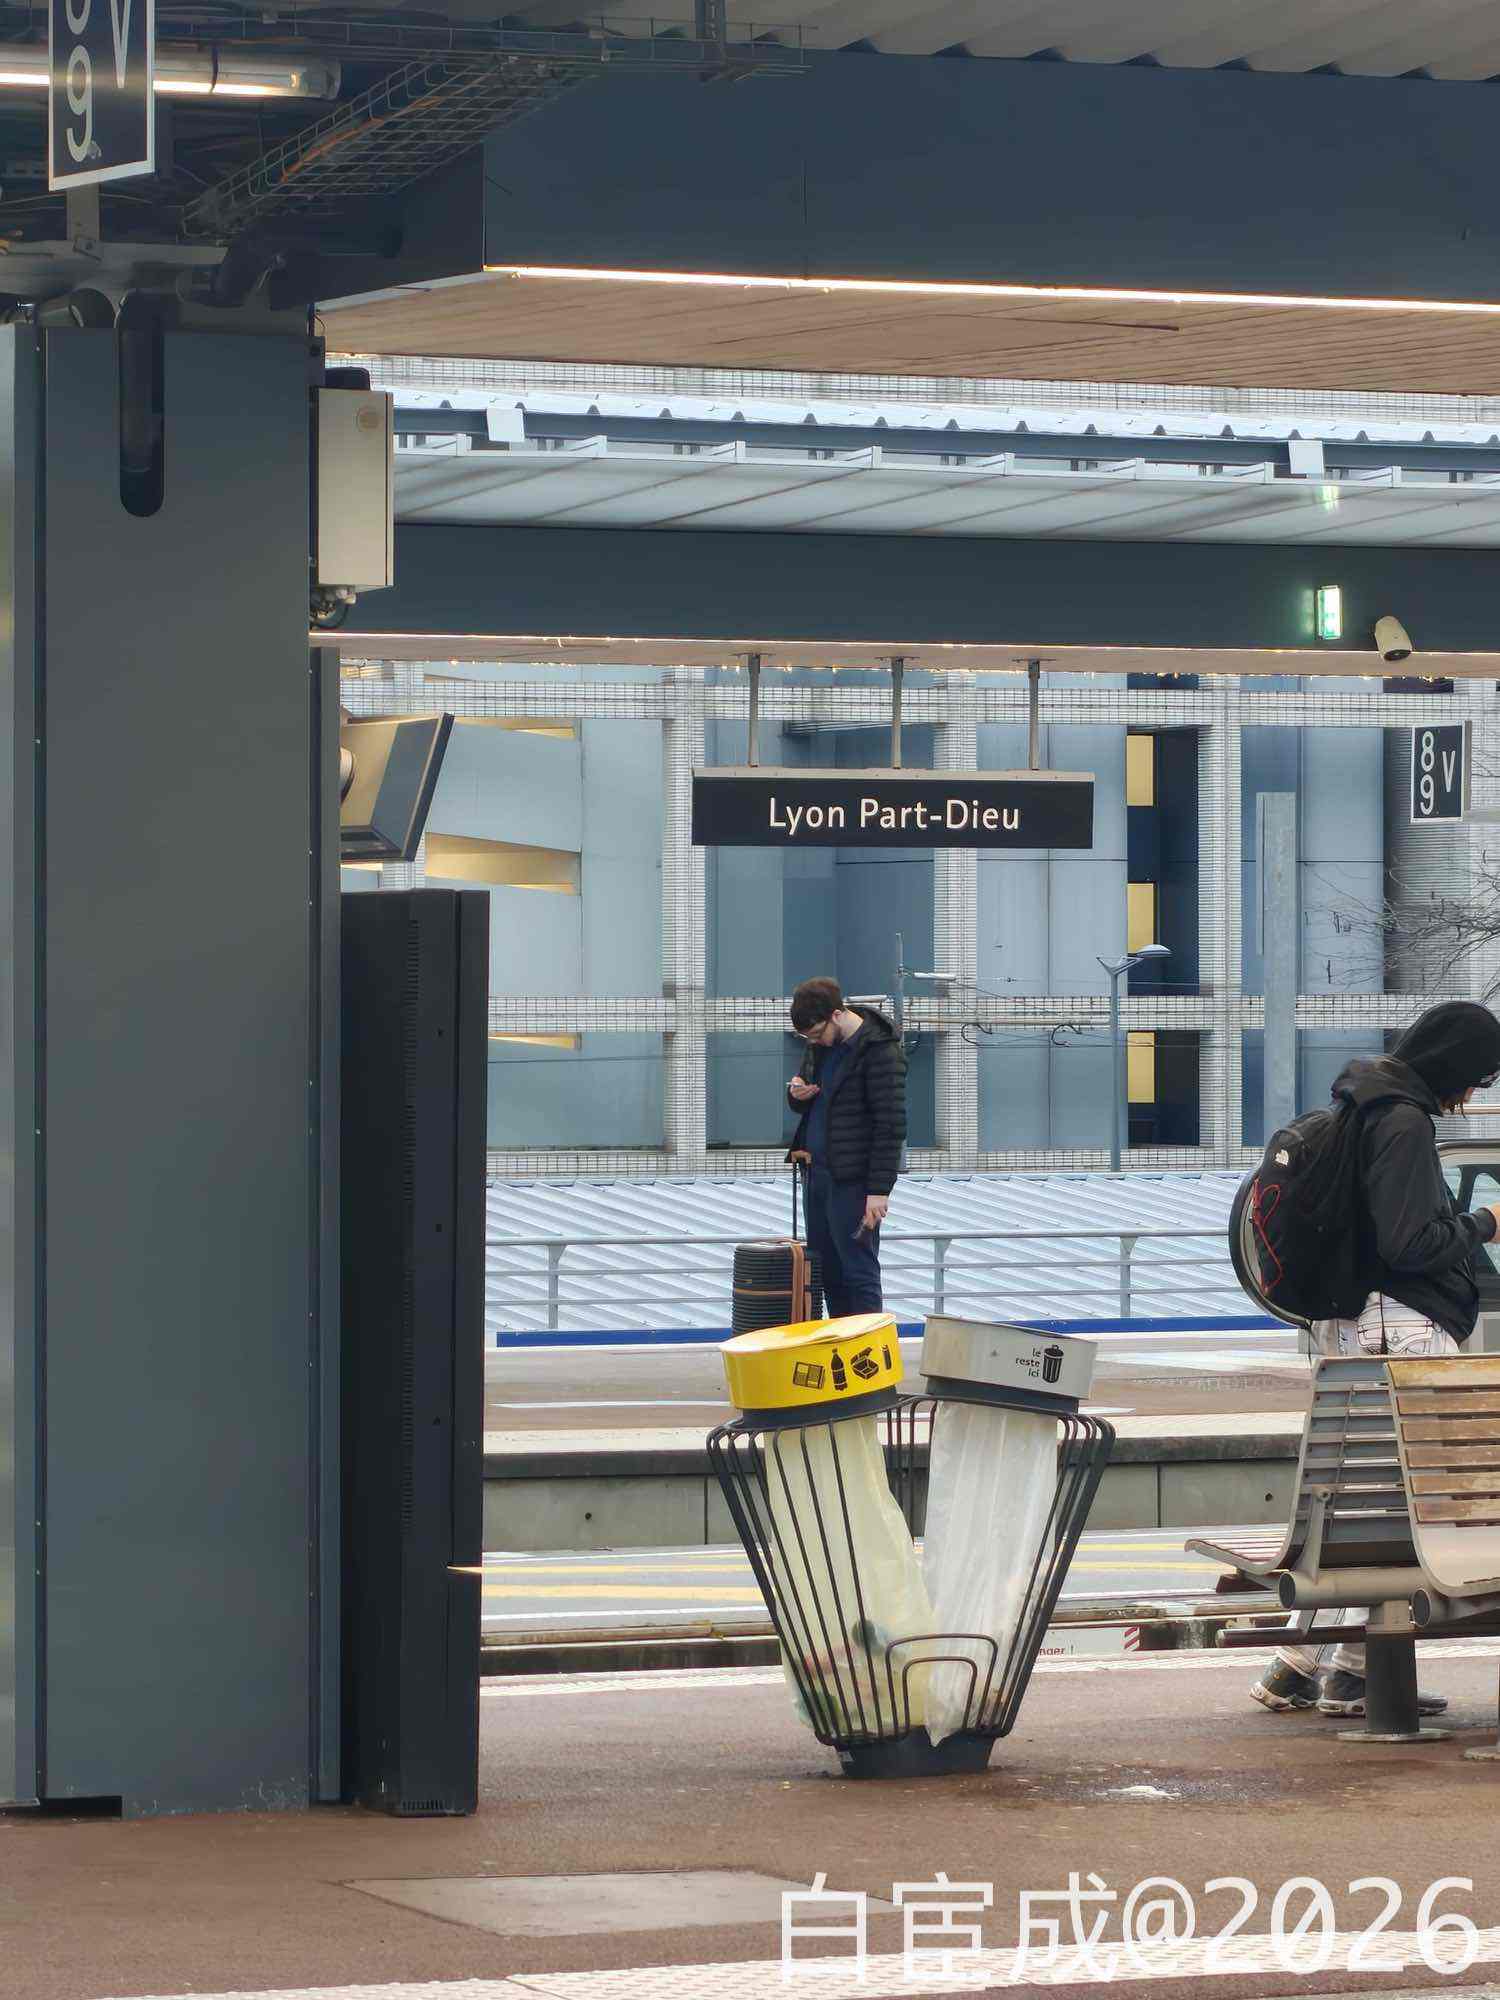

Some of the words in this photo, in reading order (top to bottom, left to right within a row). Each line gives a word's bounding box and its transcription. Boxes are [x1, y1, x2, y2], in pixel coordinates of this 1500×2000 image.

[66, 44, 92, 162] 9
[1420, 730, 1435, 772] 8
[1442, 750, 1456, 793] V
[1420, 773, 1434, 815] 9
[769, 797, 845, 836] Lyon
[860, 798, 1020, 830] Part-Dieu
[1015, 1357, 1041, 1368] reste
[1028, 1367, 1040, 1377] ici
[1032, 1347, 1041, 1358] le
